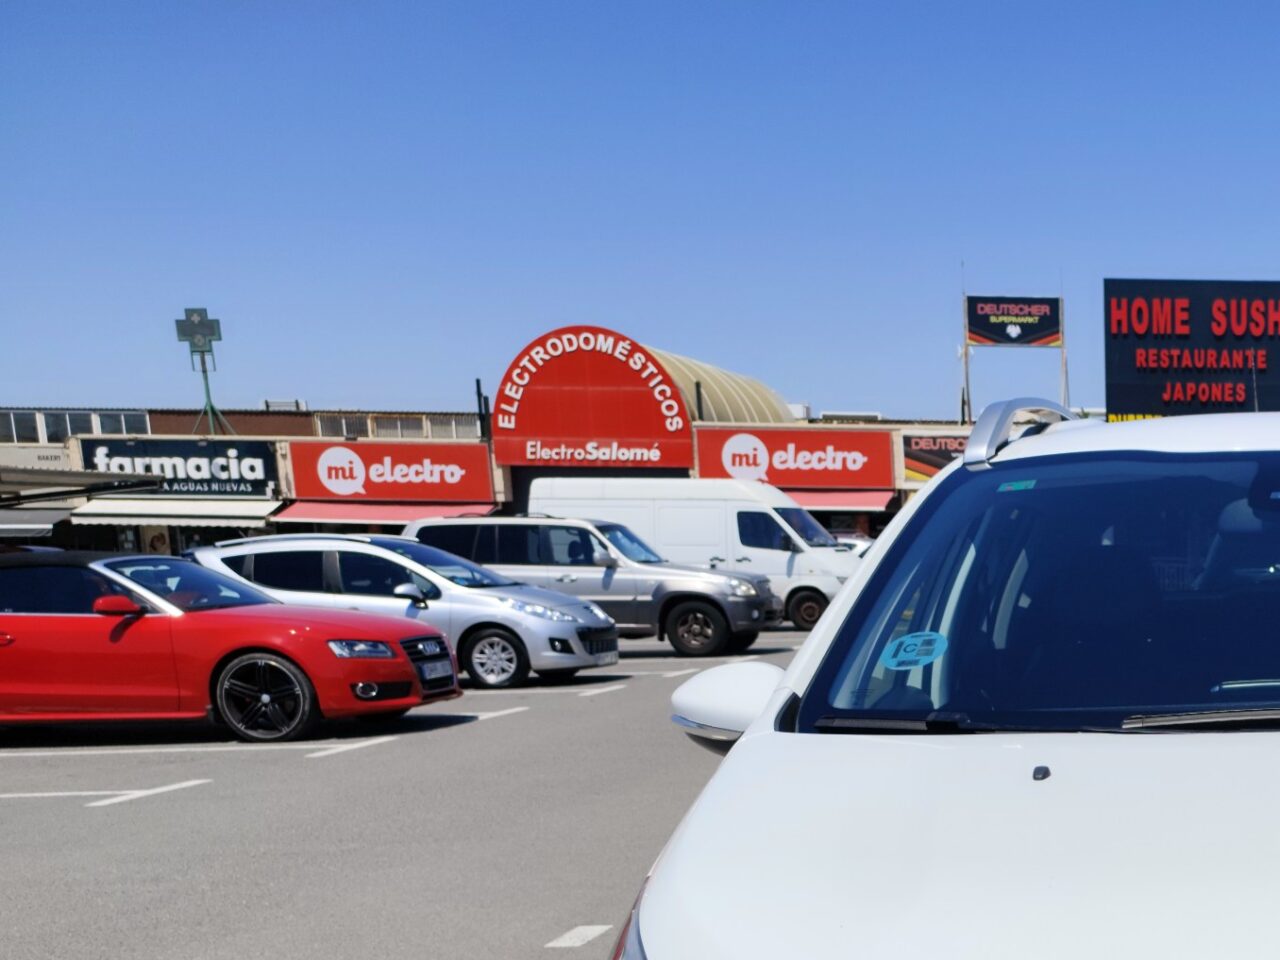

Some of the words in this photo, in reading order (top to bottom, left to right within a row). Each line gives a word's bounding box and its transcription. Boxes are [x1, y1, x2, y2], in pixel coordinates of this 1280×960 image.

[976, 303, 1051, 316] DEUTSCHER
[1109, 297, 1191, 335] HOME
[1135, 348, 1268, 369] RESTAURANTE
[497, 332, 684, 433] ELECTRODOMÉSTICOS
[1161, 382, 1247, 403] JAPONES
[526, 440, 661, 462] ElectroSalomé
[911, 437, 968, 450] DEUTSC
[94, 446, 265, 481] farmacia
[731, 447, 761, 468] mi
[771, 443, 868, 471] electro
[326, 460, 358, 481] mi
[368, 456, 466, 484] electro
[172, 481, 209, 492] AGUAS
[210, 481, 253, 492] NUEVAS
